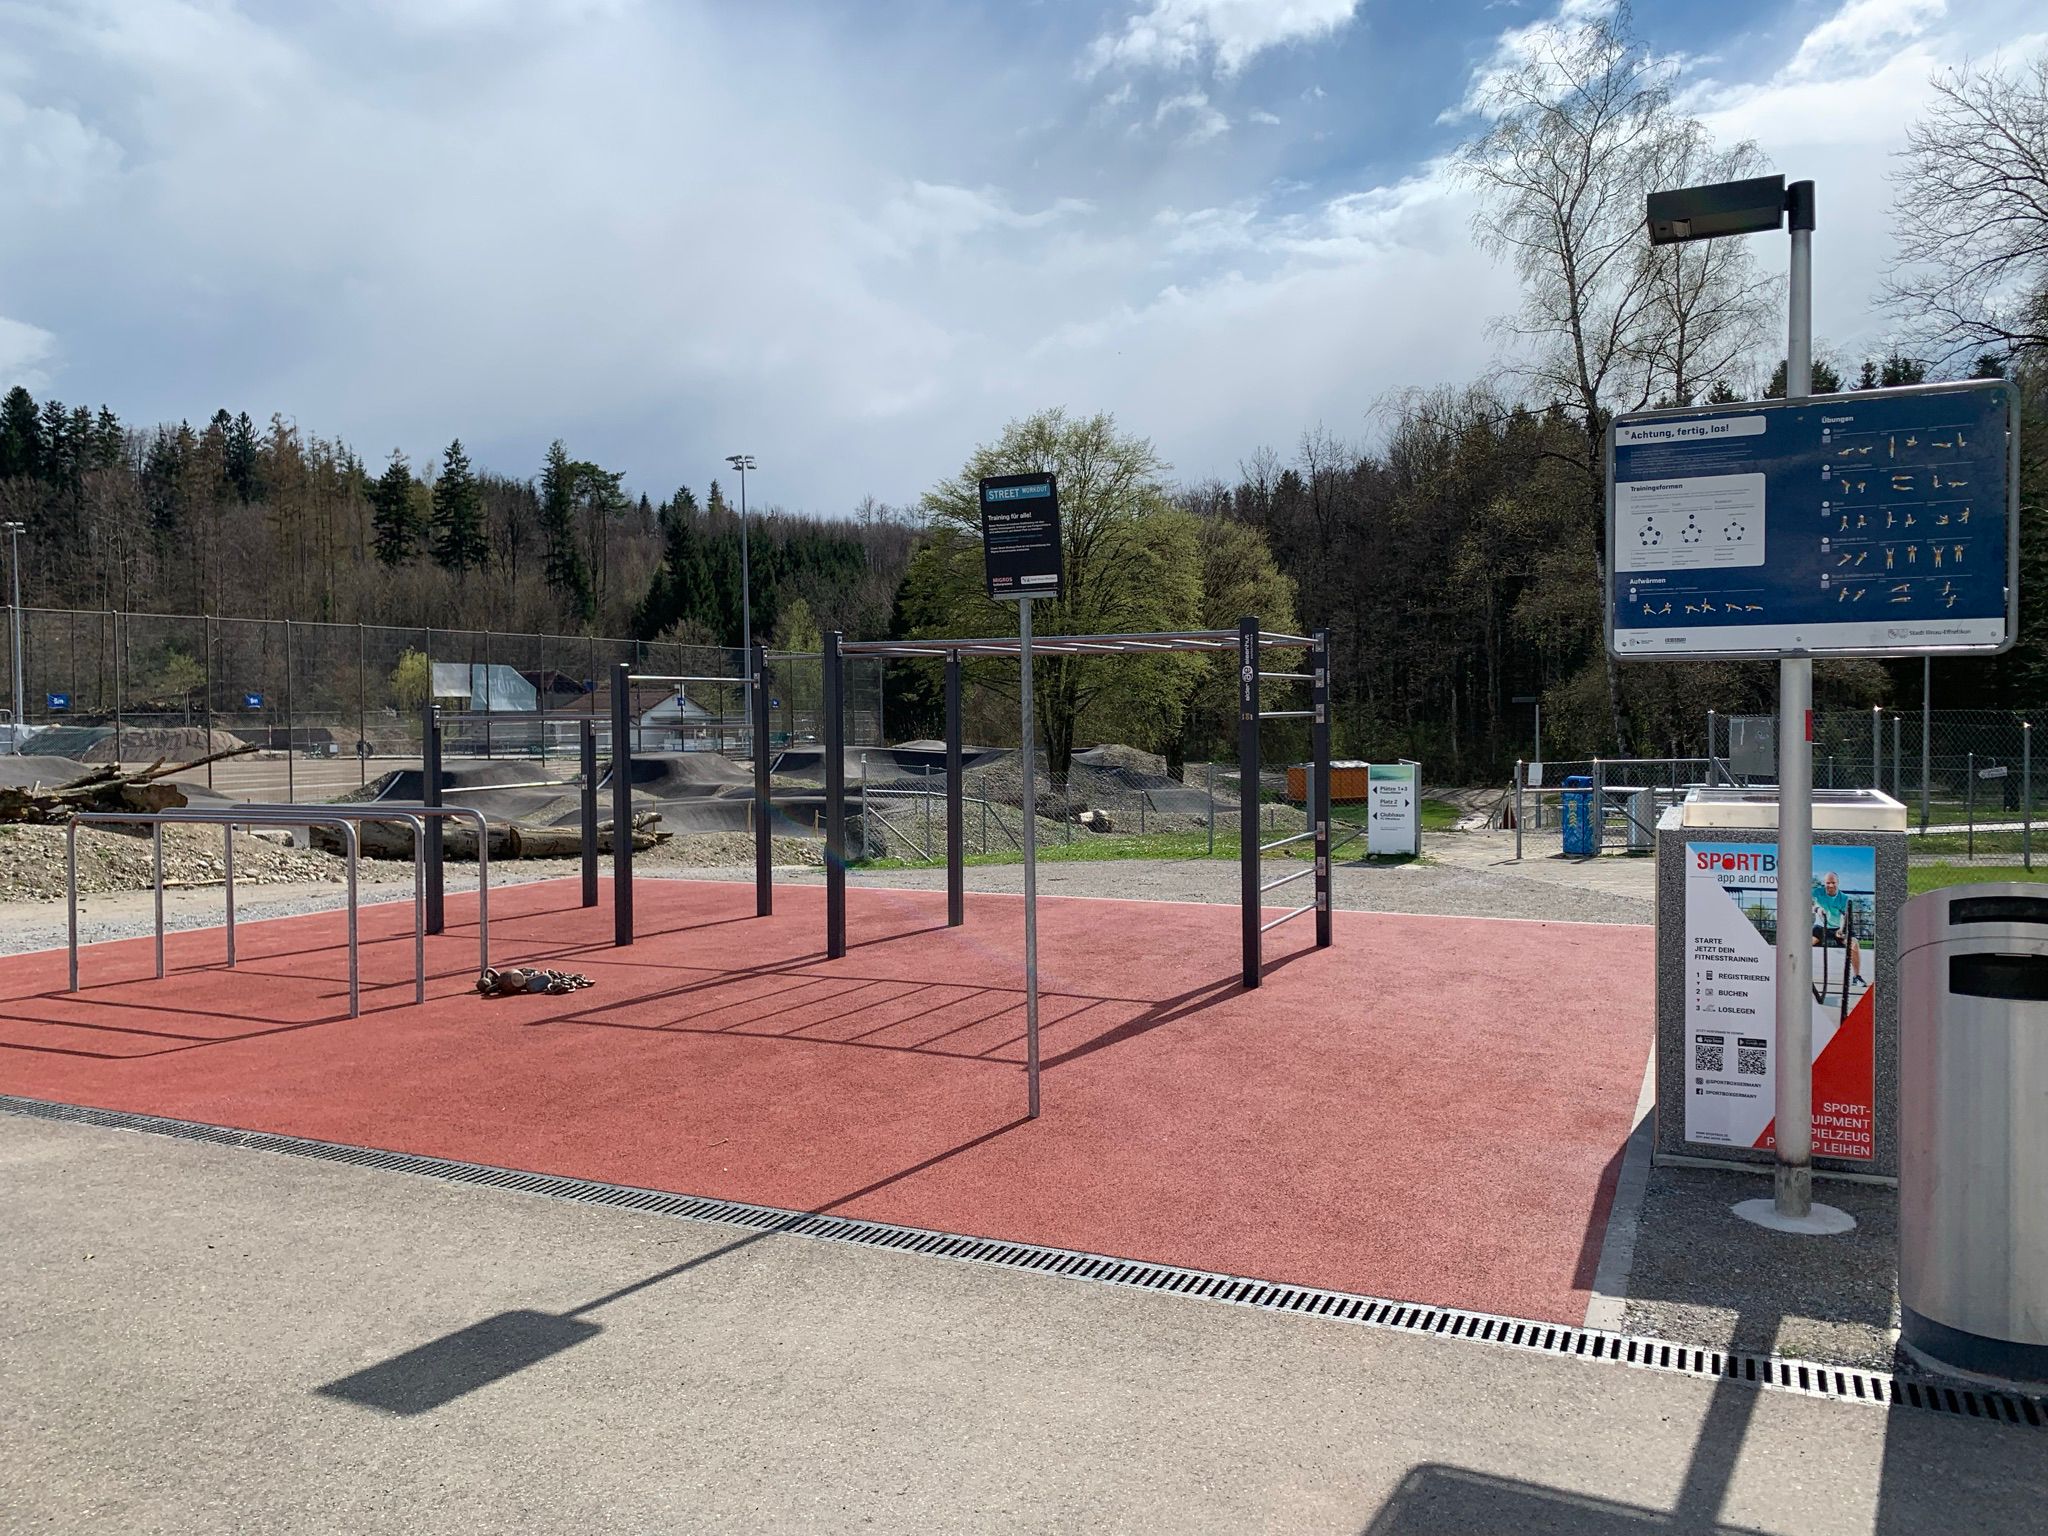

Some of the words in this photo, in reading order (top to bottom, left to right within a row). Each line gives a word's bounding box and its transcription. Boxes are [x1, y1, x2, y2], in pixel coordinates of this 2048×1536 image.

[1821, 416, 1854, 424] Übungen
[1630, 430, 1675, 440] Achtung,
[1677, 426, 1708, 436] fertig,
[1711, 424, 1729, 433] los!
[988, 488, 1020, 500] STREET
[1021, 485, 1048, 494] WORKOUT
[1630, 483, 1683, 492] Trainingsformen
[1020, 511, 1032, 519] alle!
[1629, 577, 1667, 585] Aufwärmen
[1697, 852, 1779, 872] SPORTB
[1717, 874, 1735, 884] app
[1738, 873, 1756, 884] and
[1694, 937, 1723, 945] STARTE
[1694, 945, 1716, 953] JETZT
[1718, 946, 1735, 954] DEIN
[1694, 953, 1759, 964] FITNESSTRAINING
[1718, 972, 1770, 982] REGISTRIEREN
[1718, 989, 1748, 998] BUCHEN
[1718, 1006, 1755, 1015] LOSLEGEN
[1823, 1102, 1871, 1116] SPORT-
[1811, 1114, 1870, 1129] UIPMENT
[1811, 1127, 1870, 1143] PIELZEUG
[1824, 1143, 1870, 1156] LEIHEN
